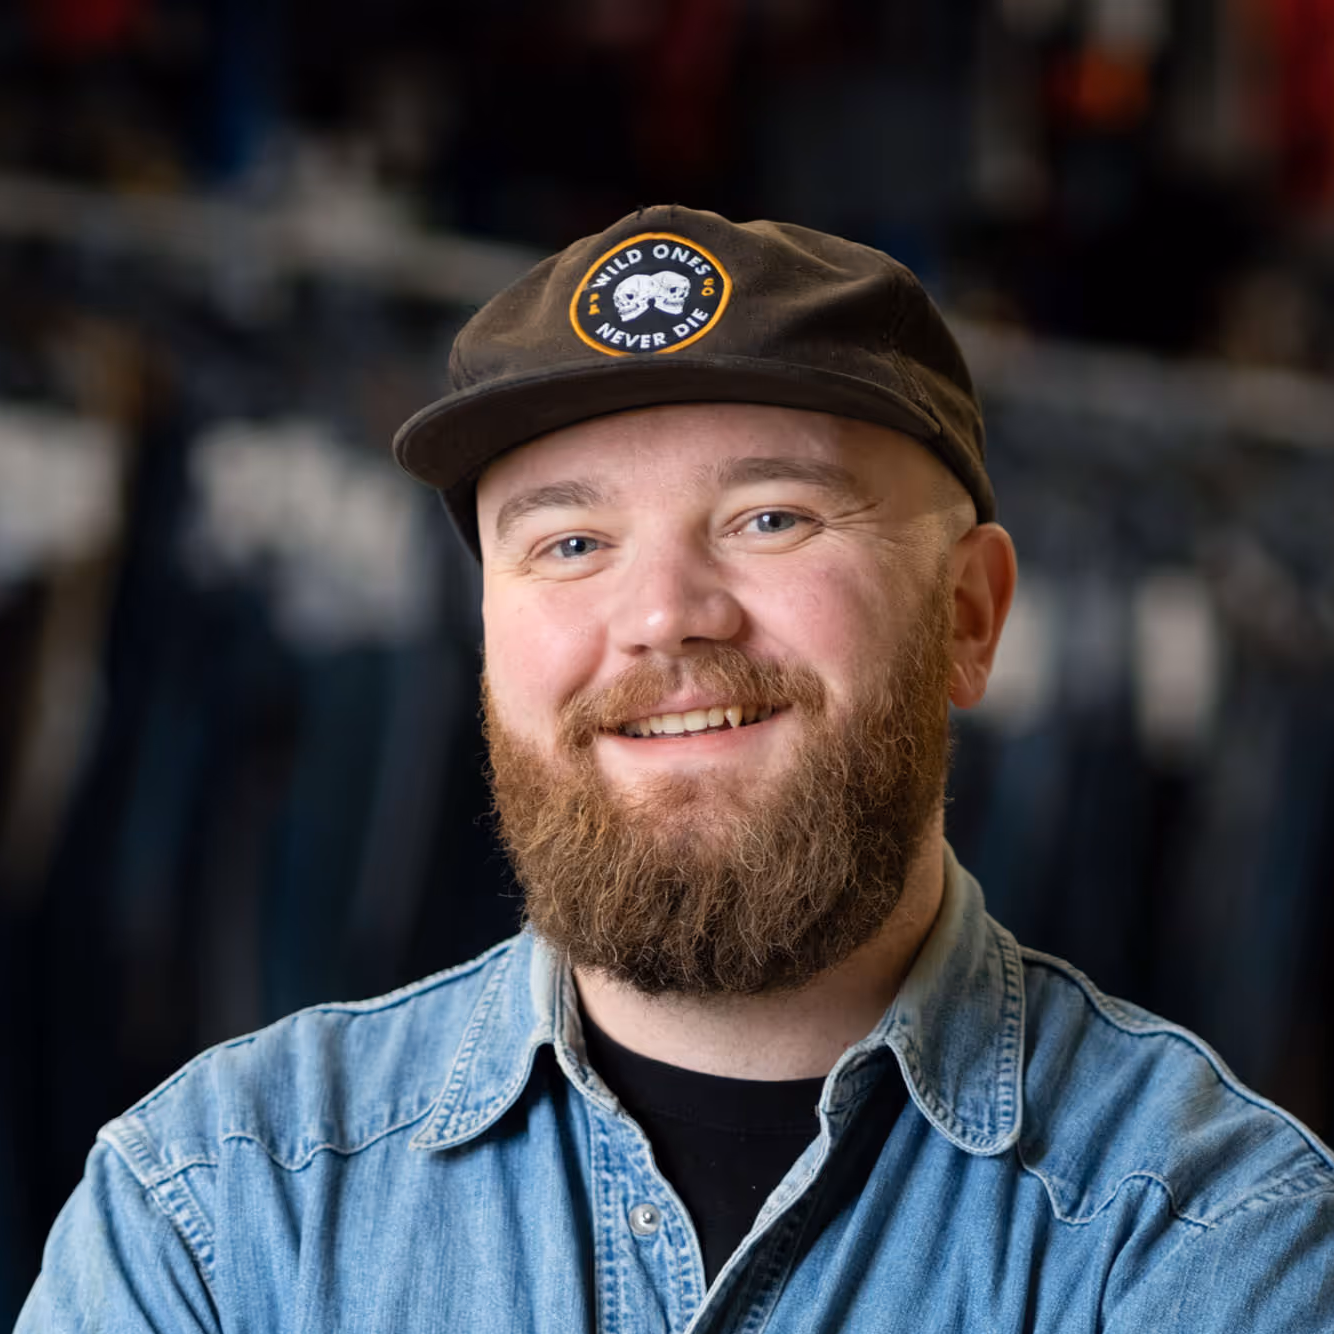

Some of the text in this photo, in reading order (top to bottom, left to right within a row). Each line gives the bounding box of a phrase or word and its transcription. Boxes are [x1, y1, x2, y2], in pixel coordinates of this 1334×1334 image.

[591, 244, 712, 288] WILD ONES
[595, 308, 709, 349] NEVER DIE
